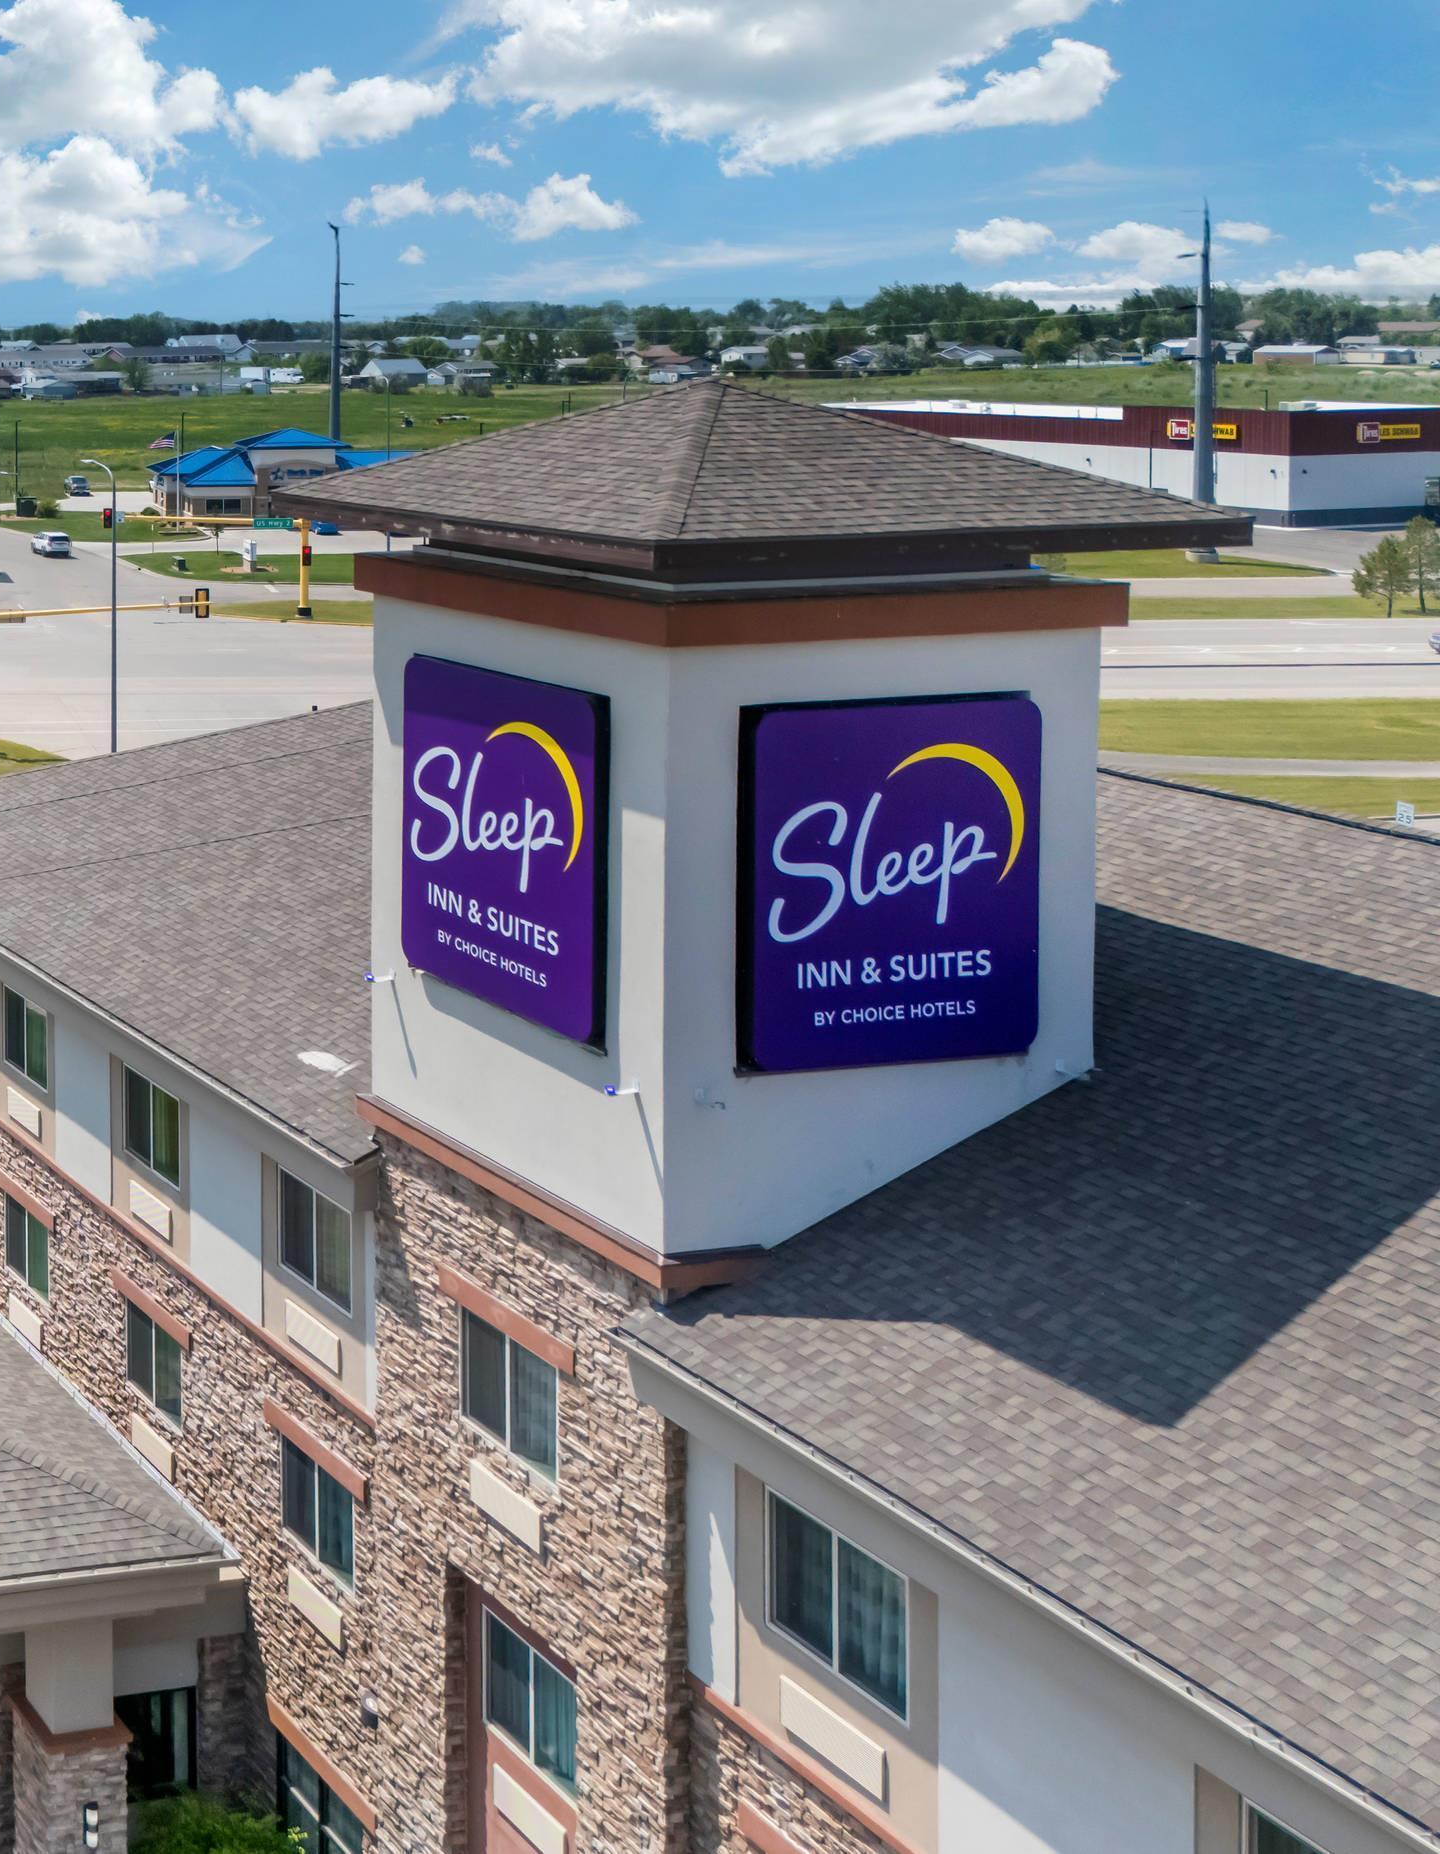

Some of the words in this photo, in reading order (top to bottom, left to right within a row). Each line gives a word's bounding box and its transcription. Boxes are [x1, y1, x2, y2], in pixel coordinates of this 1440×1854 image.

[1171, 422, 1188, 436] Tires
[1363, 425, 1378, 440] Tires
[411, 746, 564, 893] Sleep
[1398, 812, 1412, 824] 25
[768, 792, 998, 943] Sleep
[427, 882, 463, 917] INN
[467, 899, 483, 927] &
[486, 906, 560, 956] SUITES
[437, 929, 452, 946] BY
[454, 937, 497, 967] CHOICE
[500, 956, 548, 988] HOTELS
[797, 959, 852, 989] INN
[860, 956, 882, 984] &
[889, 949, 992, 982] SUITES
[814, 1010, 836, 1026] BY
[841, 1004, 905, 1024] CHOICE
[910, 999, 976, 1019] HOTELS
